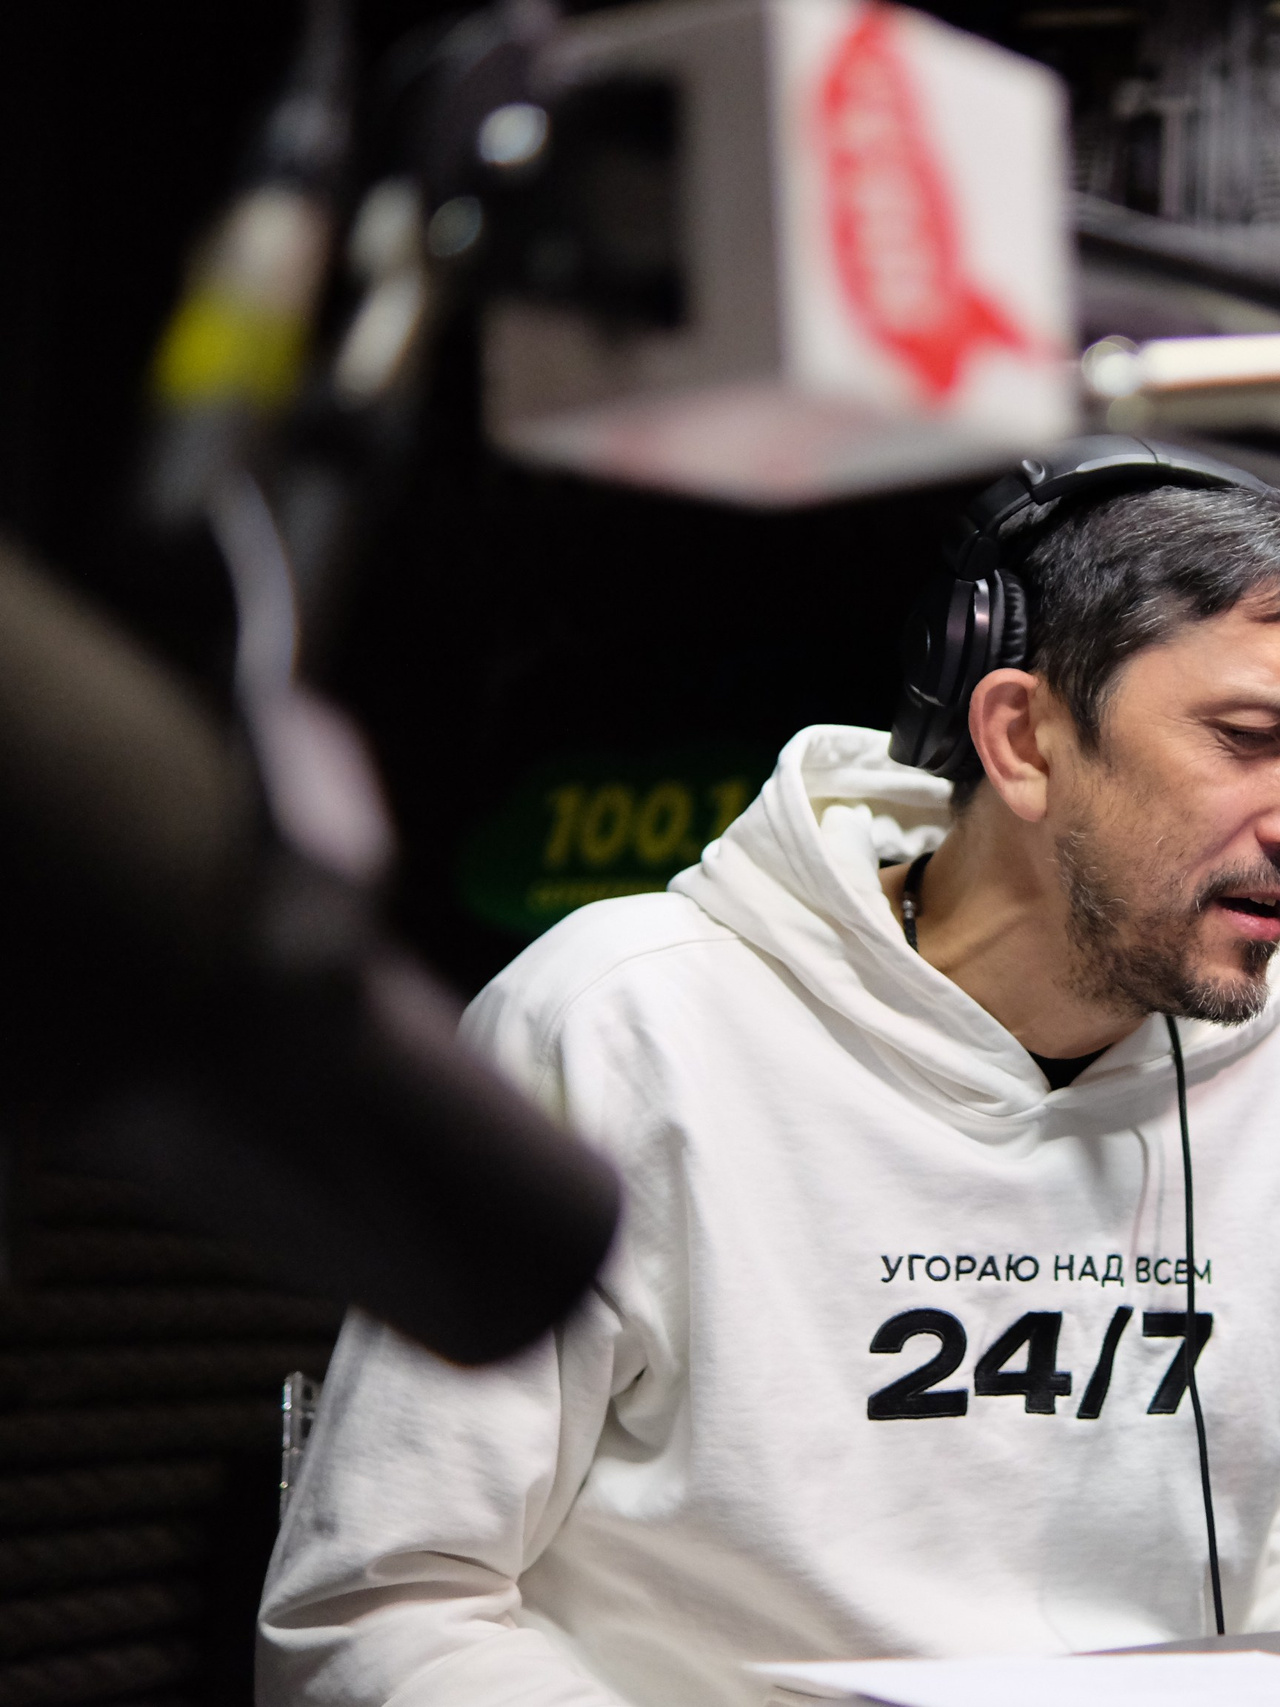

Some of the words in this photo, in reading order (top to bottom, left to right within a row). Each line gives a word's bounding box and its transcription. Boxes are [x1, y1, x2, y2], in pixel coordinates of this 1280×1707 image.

[881, 1253, 1040, 1283] УГОРАЮ
[1053, 1253, 1125, 1288] НАД
[1135, 1256, 1212, 1286] ВСЕМ
[867, 1305, 1214, 1420] 24/7
